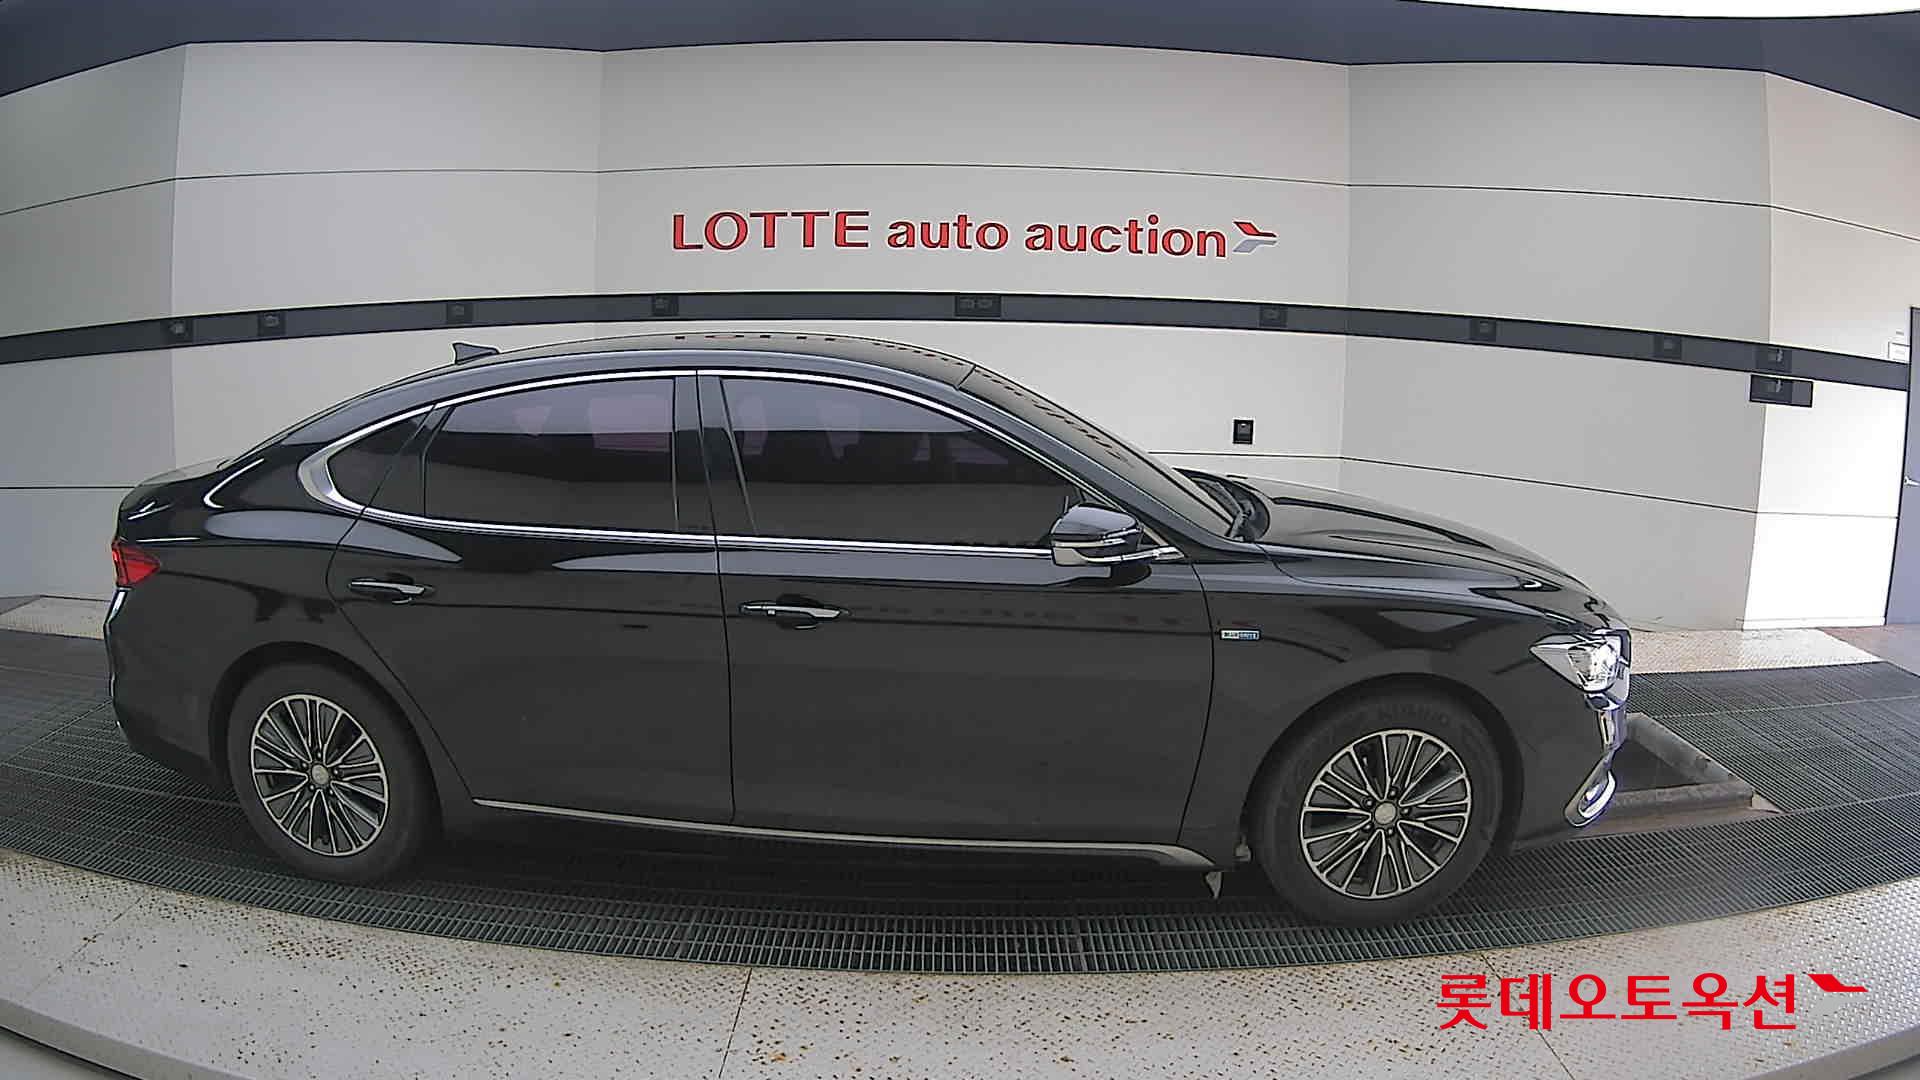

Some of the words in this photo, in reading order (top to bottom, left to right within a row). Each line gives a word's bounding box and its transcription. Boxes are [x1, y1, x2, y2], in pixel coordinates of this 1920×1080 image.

[672, 211, 869, 250] LOTTE
[887, 214, 1009, 250] auto
[1025, 214, 1228, 257] auction
